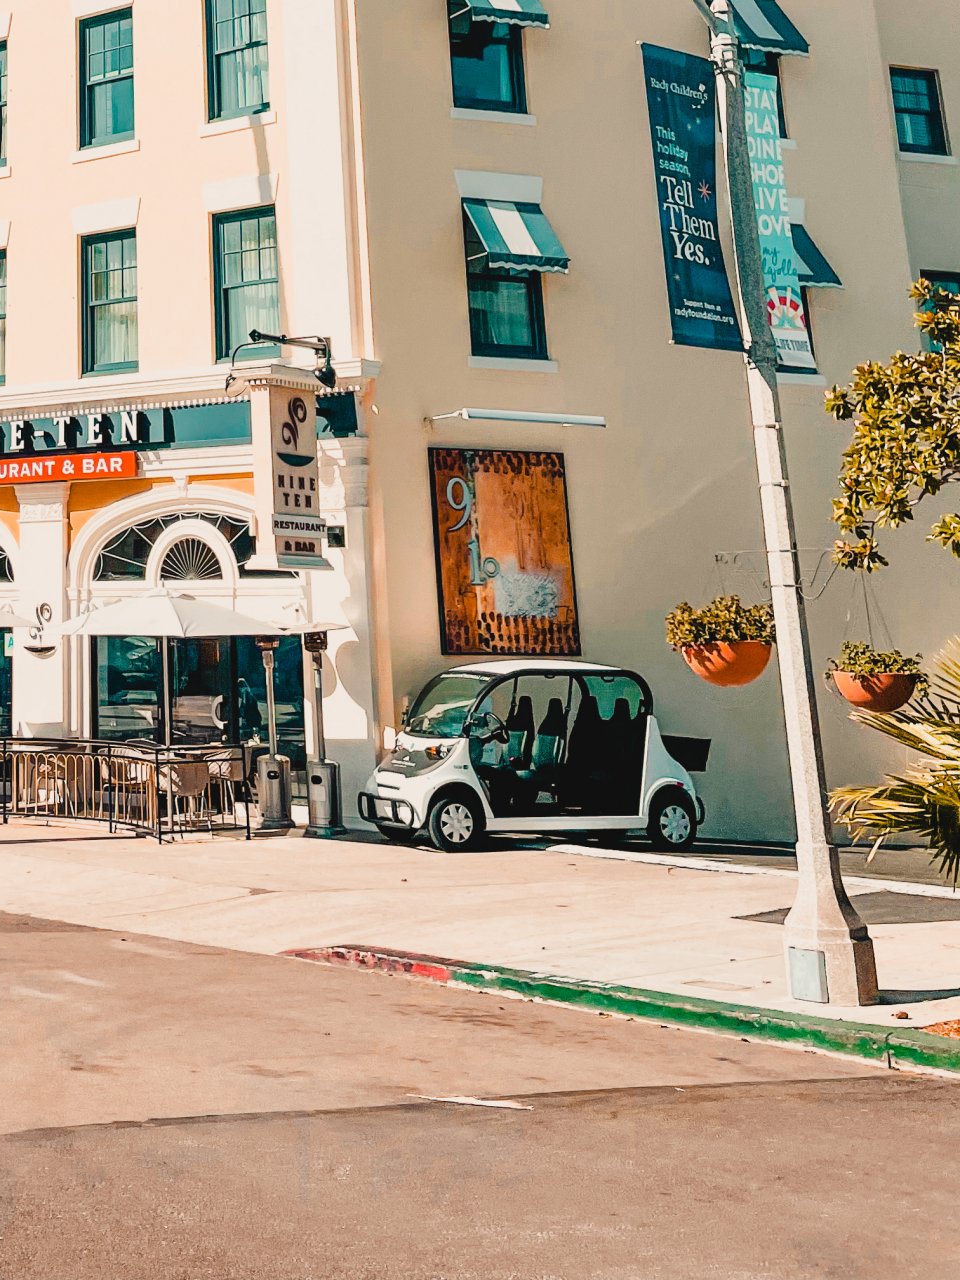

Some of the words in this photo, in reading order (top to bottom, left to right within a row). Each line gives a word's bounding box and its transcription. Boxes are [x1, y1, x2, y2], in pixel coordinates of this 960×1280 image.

[650, 77, 669, 93] Rady
[656, 126, 676, 140] This
[657, 141, 688, 162] holiday
[659, 159, 691, 177] season,
[660, 176, 694, 208] Tell
[755, 187, 789, 211] IVE
[663, 203, 716, 240] Them
[758, 215, 792, 236] OVE
[670, 231, 710, 265] Yes.
[62, 460, 75, 474] &
[82, 457, 123, 474] BAR
[278, 474, 316, 491] NINE
[283, 492, 312, 508] TEN
[446, 477, 473, 532] 9
[274, 520, 326, 532] RESTAURANT
[295, 541, 315, 552] BAR
